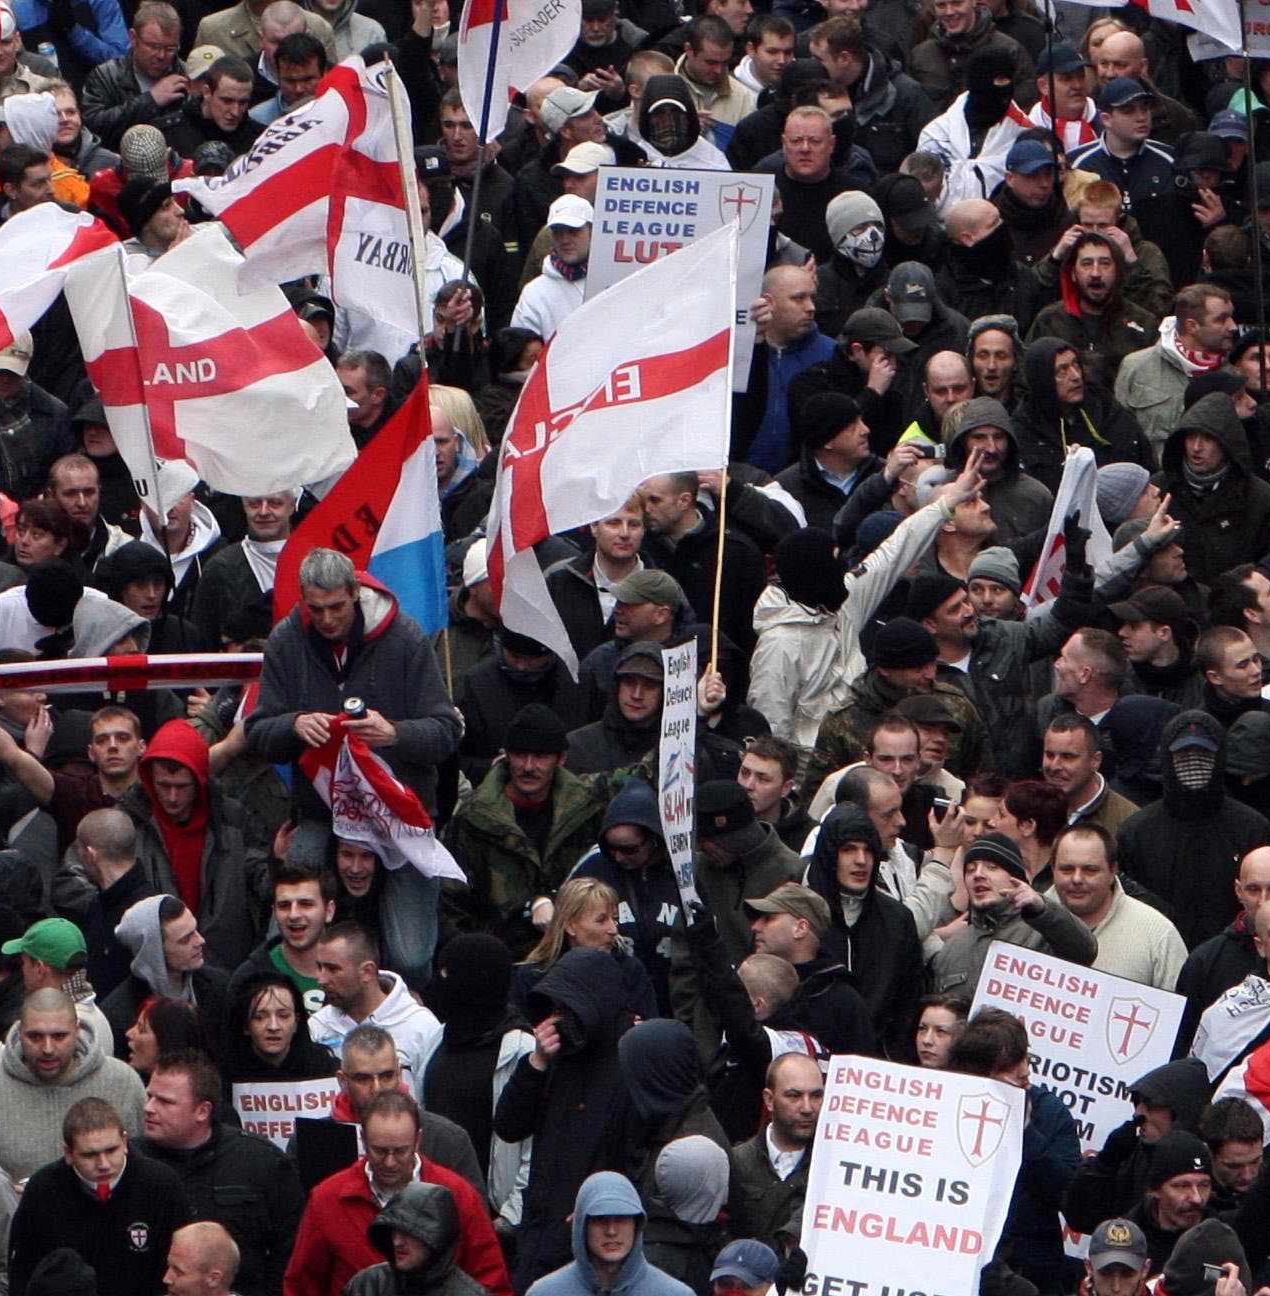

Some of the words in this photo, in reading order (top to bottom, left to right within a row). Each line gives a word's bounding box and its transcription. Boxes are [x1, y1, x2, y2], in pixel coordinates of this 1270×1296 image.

[606, 177, 700, 195] ENGLISH
[604, 198, 698, 216] DEFENCE
[602, 220, 696, 237] LEAGUE
[663, 716, 690, 739] League
[994, 953, 1099, 999] ENGLISH
[986, 978, 1092, 1024] DEFENCE
[835, 1067, 943, 1100] ENGLISH
[1028, 1053, 1138, 1104] RIOTISM
[240, 1091, 336, 1112] ENGLISH
[829, 1095, 939, 1129] DEFENCE
[824, 1123, 934, 1157] LEAGUE
[840, 1160, 923, 1198] THIS
[935, 1178, 970, 1206] IS
[813, 1204, 983, 1255] ENGLAND
